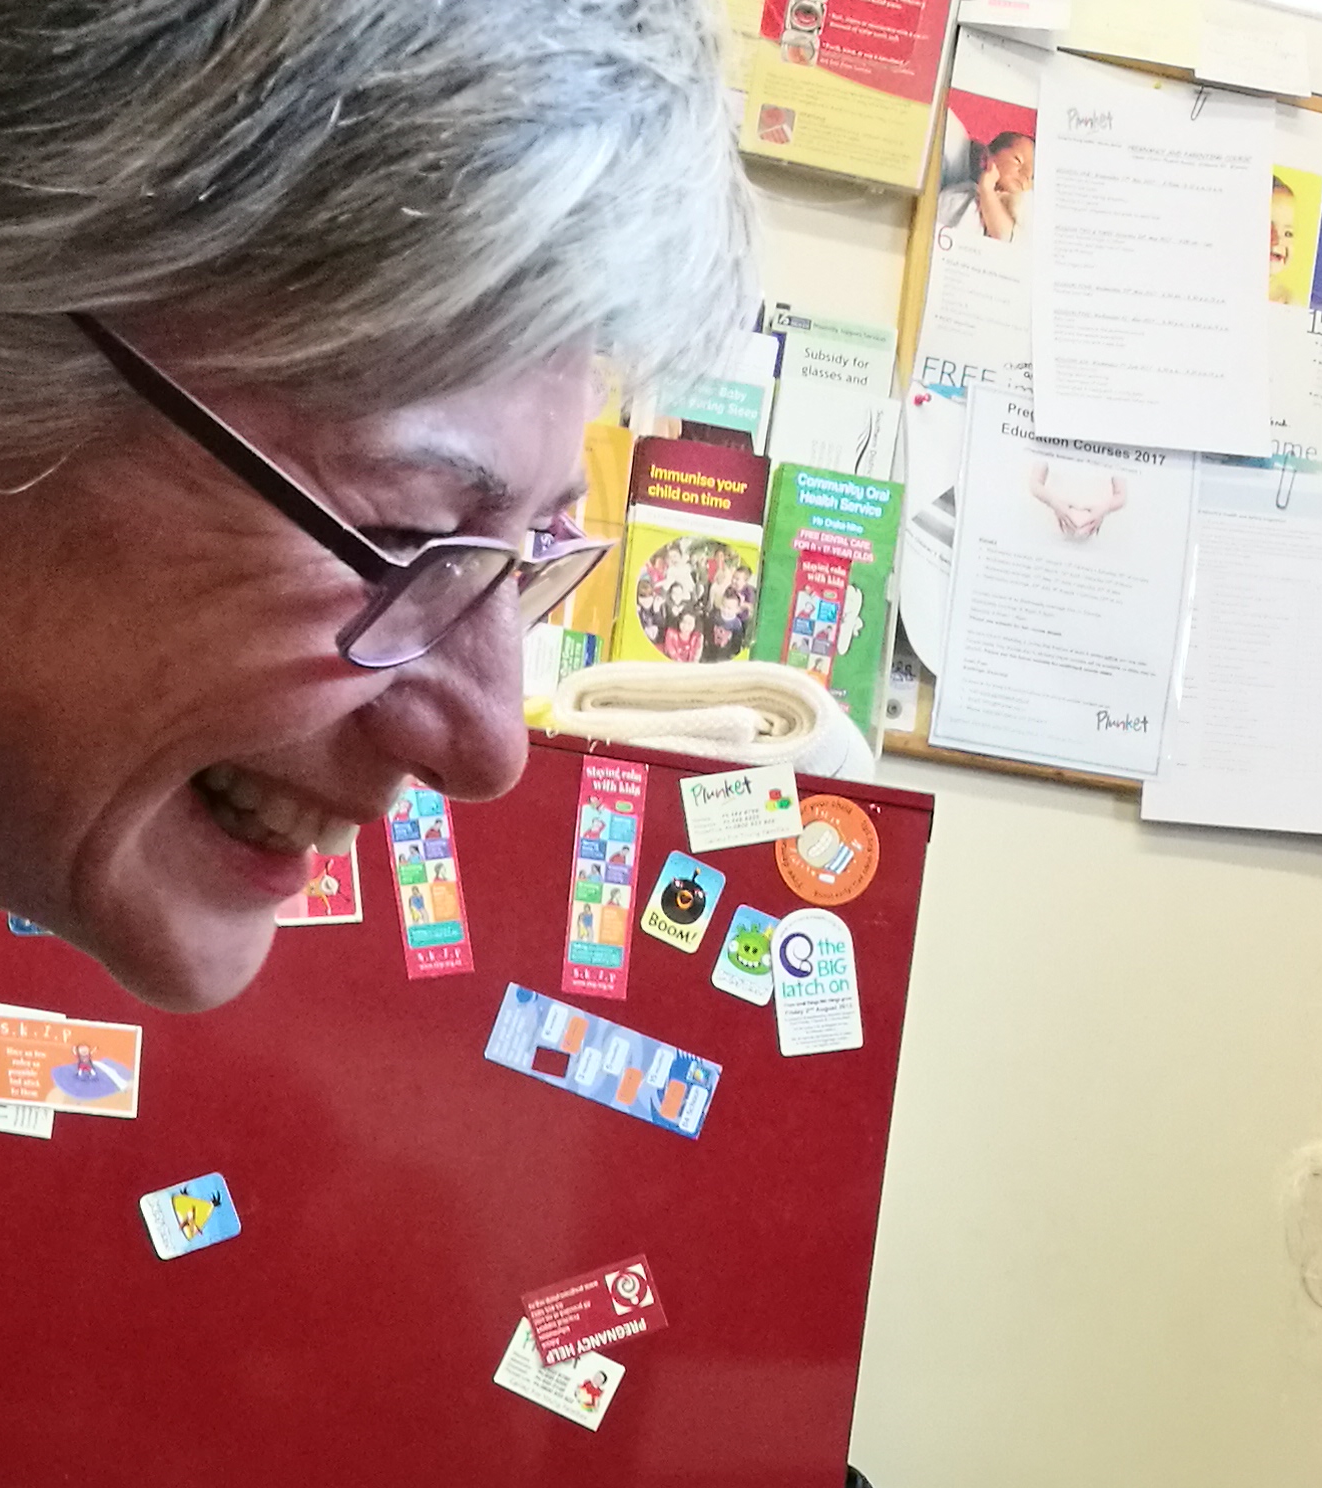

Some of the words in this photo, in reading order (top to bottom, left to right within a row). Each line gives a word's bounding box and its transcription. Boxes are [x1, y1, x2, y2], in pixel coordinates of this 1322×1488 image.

[937, 225, 954, 251] 6
[804, 346, 849, 369] Subsidy
[852, 355, 870, 370] for
[801, 363, 843, 382] glasses
[845, 372, 868, 386] and
[719, 386, 747, 403] Baby
[728, 401, 759, 421] Sleep
[1073, 438, 1131, 460] Courses
[1134, 449, 1167, 467] 2017
[650, 463, 716, 489] Immunise
[716, 477, 748, 494] your
[797, 472, 866, 499] Community
[866, 484, 891, 502] Oral
[647, 483, 681, 501] child
[681, 490, 700, 505] on
[700, 492, 732, 510] time
[799, 489, 839, 510] Health
[839, 498, 883, 518] Service
[850, 537, 872, 551] CARE
[1096, 709, 1149, 733] Plunket
[585, 765, 621, 782] Staying
[591, 778, 618, 793] with
[618, 780, 642, 796] kids
[690, 775, 754, 808] Plunket
[648, 910, 698, 944] BOOM!
[817, 938, 846, 956] the
[781, 976, 825, 998] latch
[828, 977, 850, 993] on
[576, 1316, 648, 1354] PREGNANCY
[545, 1343, 577, 1365] HELP
